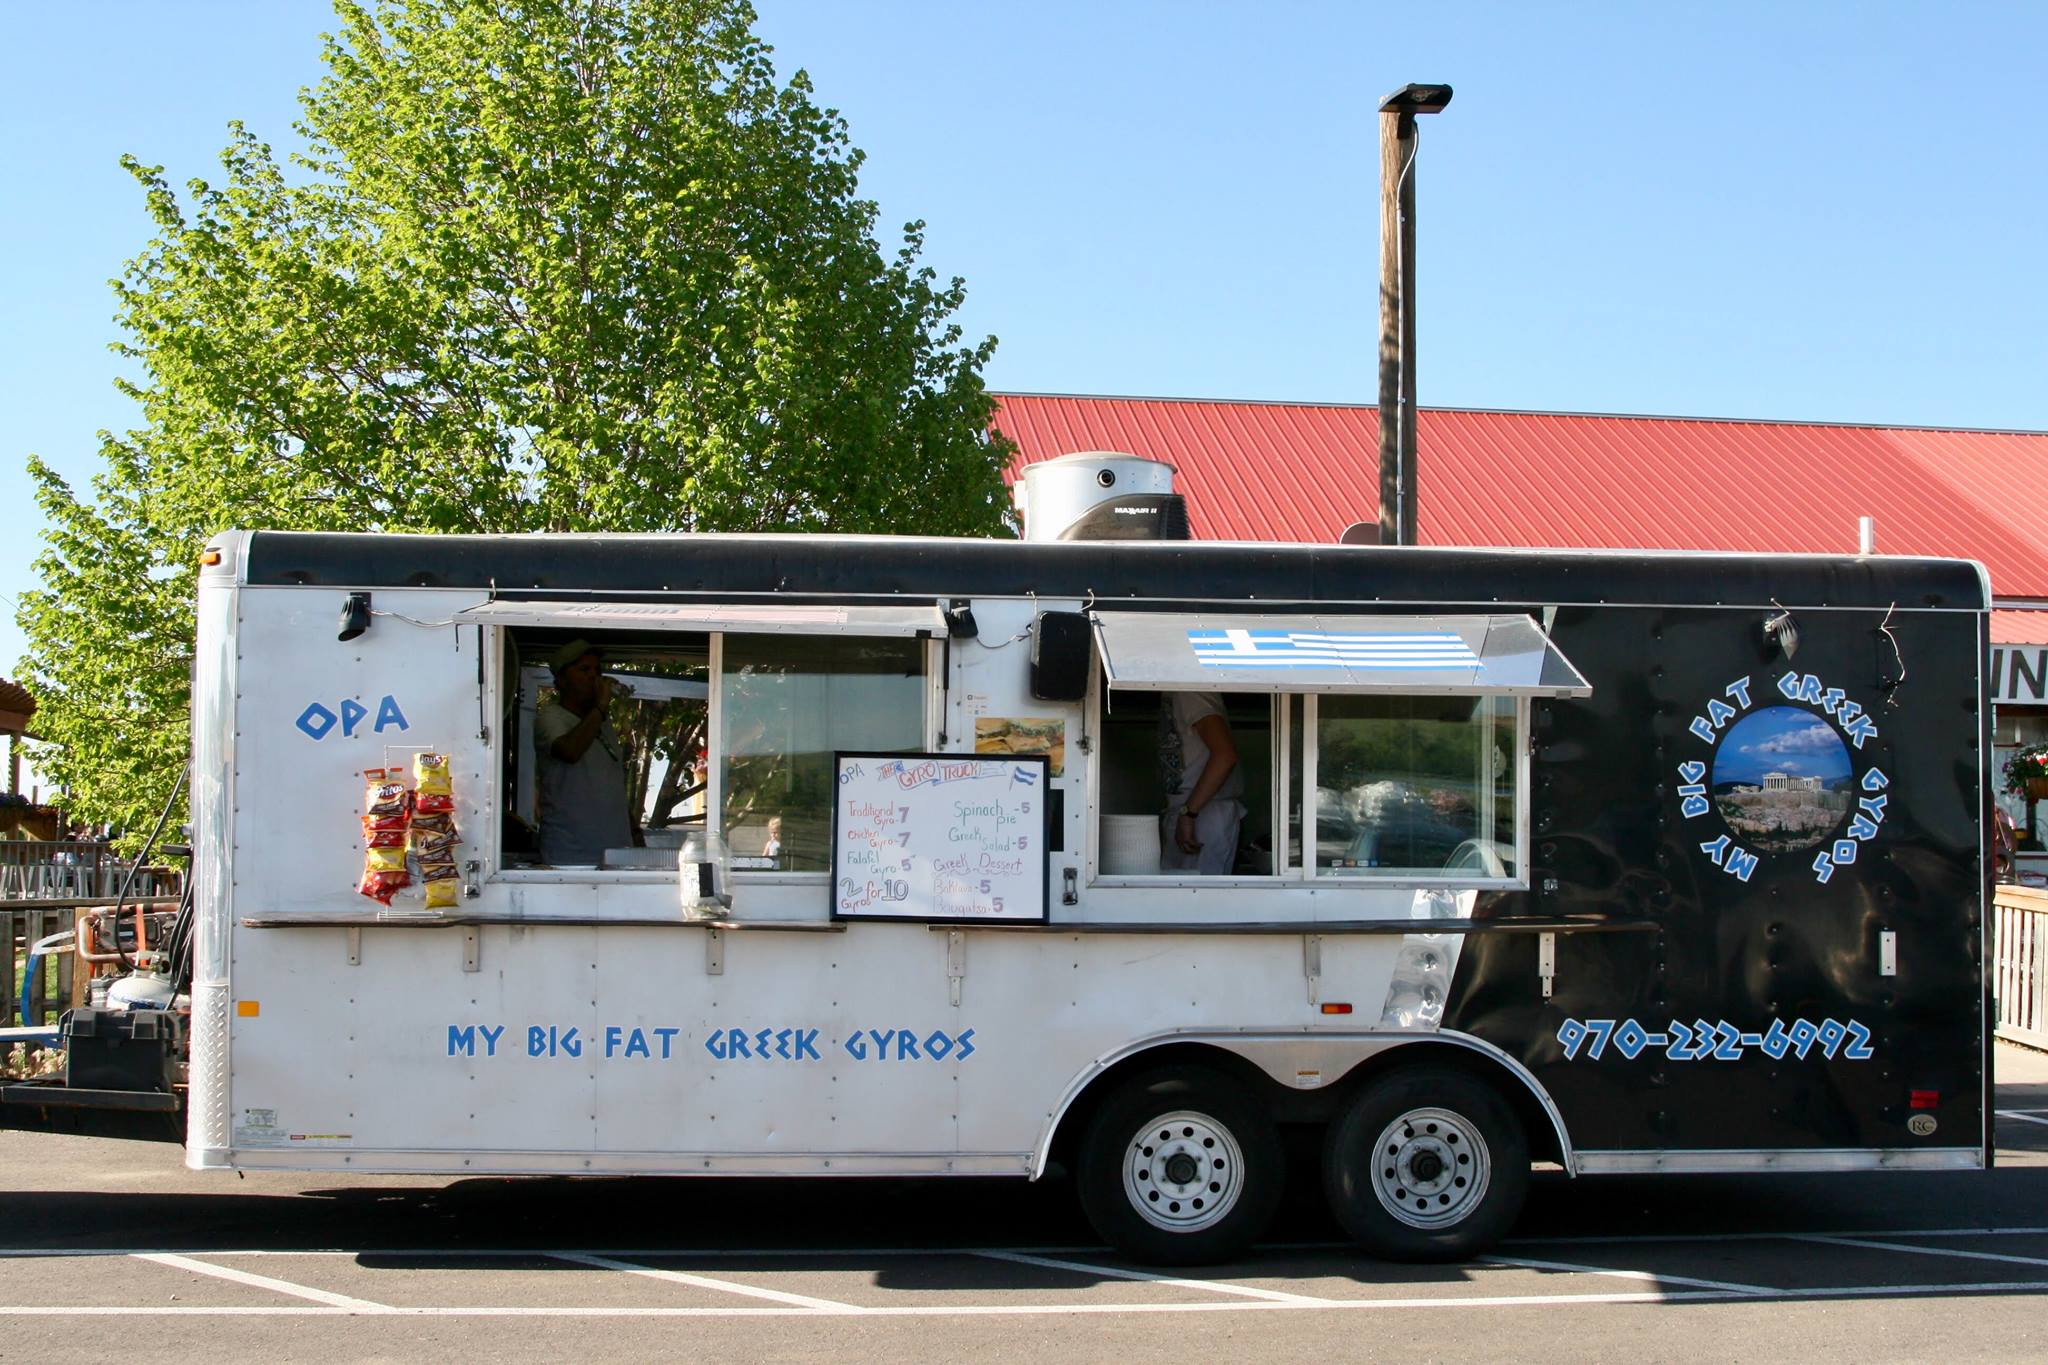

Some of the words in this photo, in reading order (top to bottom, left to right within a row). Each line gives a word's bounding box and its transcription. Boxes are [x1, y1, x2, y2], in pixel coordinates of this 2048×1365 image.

[295, 695, 410, 741] OPA
[1689, 676, 1752, 744] FAT
[1777, 671, 1877, 750] GREEK
[840, 763, 865, 784] OPA
[899, 762, 937, 788] GYRO
[941, 763, 979, 781] TRUCK
[1677, 761, 1709, 818] BIG
[848, 800, 893, 817] Traditional
[954, 799, 1003, 826] Spinach
[1812, 767, 1889, 884] GYROS
[847, 850, 880, 864] Falafel
[980, 852, 1023, 872] Dessert
[1700, 834, 1759, 882] MY
[840, 877, 863, 897] 2
[865, 880, 882, 899] for
[881, 879, 909, 901] 10
[447, 1023, 505, 1057] MY
[526, 1024, 583, 1058] BIG
[604, 1026, 680, 1060] FAT
[704, 1027, 822, 1061] GREEK
[844, 1027, 976, 1062] GYROS
[1556, 1017, 1874, 1060] 970-232-6992
